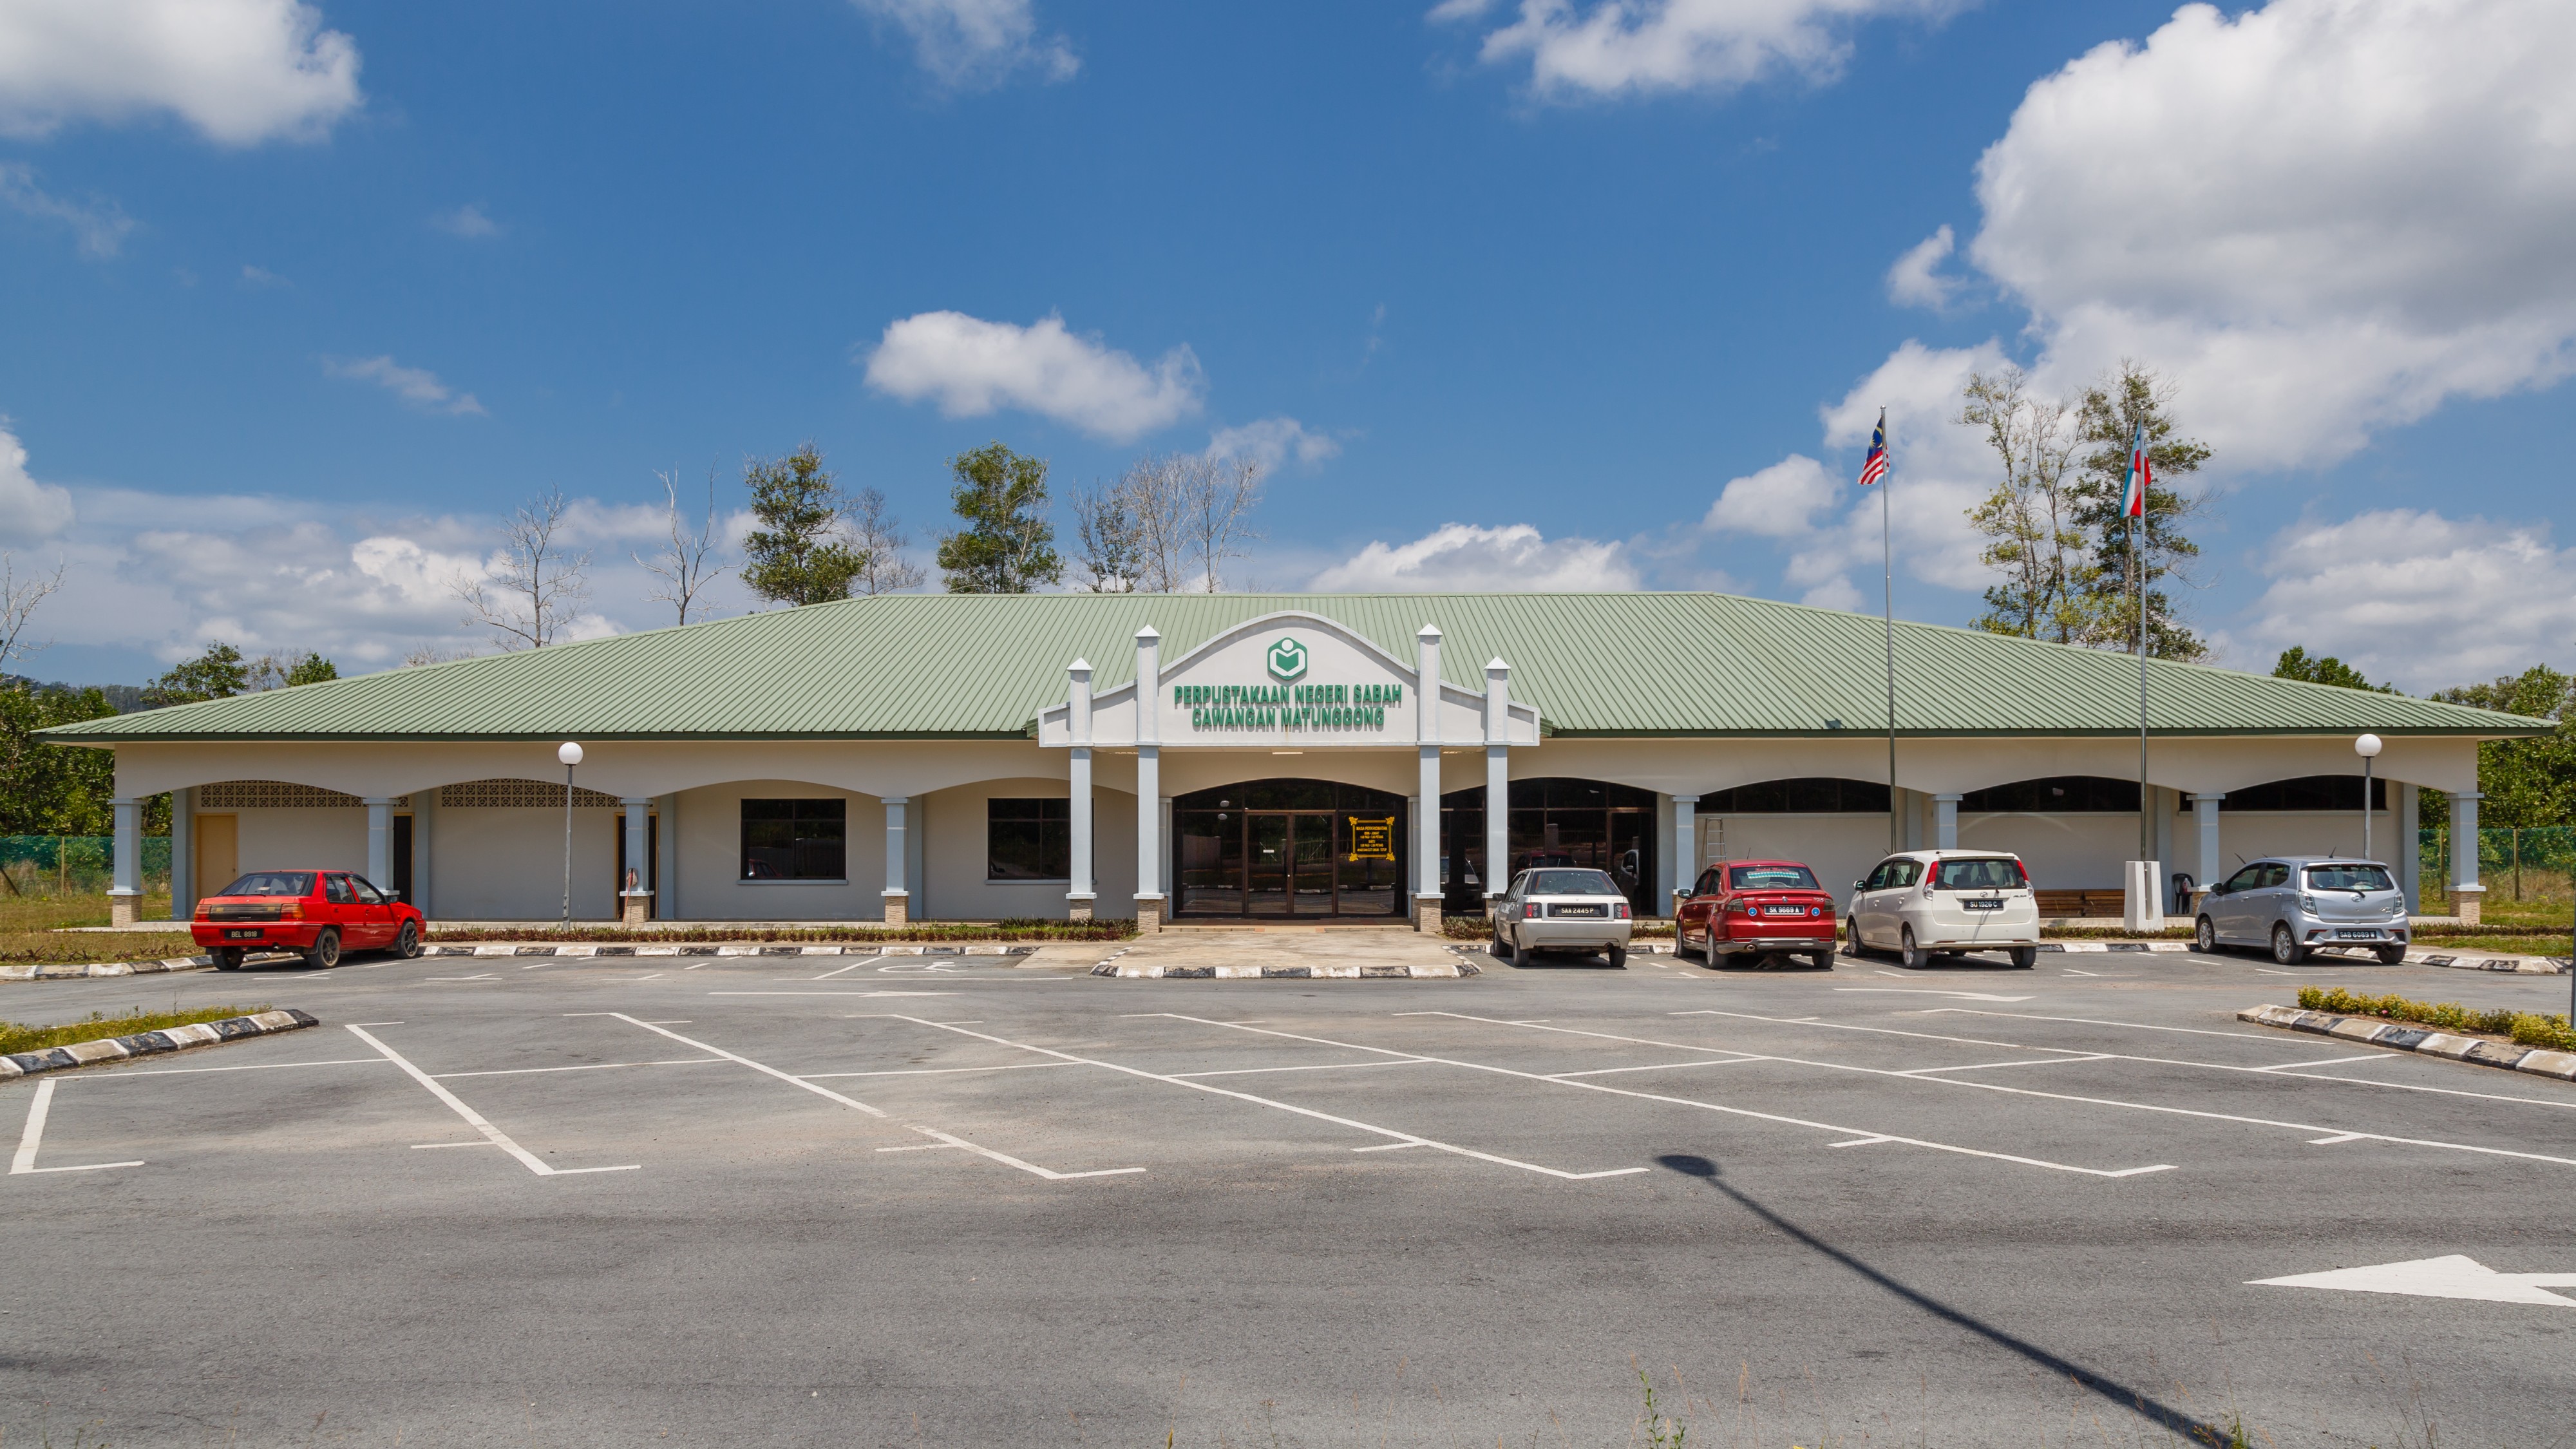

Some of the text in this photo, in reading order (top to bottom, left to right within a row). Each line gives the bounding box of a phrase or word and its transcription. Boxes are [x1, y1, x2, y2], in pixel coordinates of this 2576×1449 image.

[1174, 684, 1402, 703] PERPUSTAKAAN NEGERI SABAH
[1192, 707, 1385, 726] CAWANGAN MATUNGGONG
